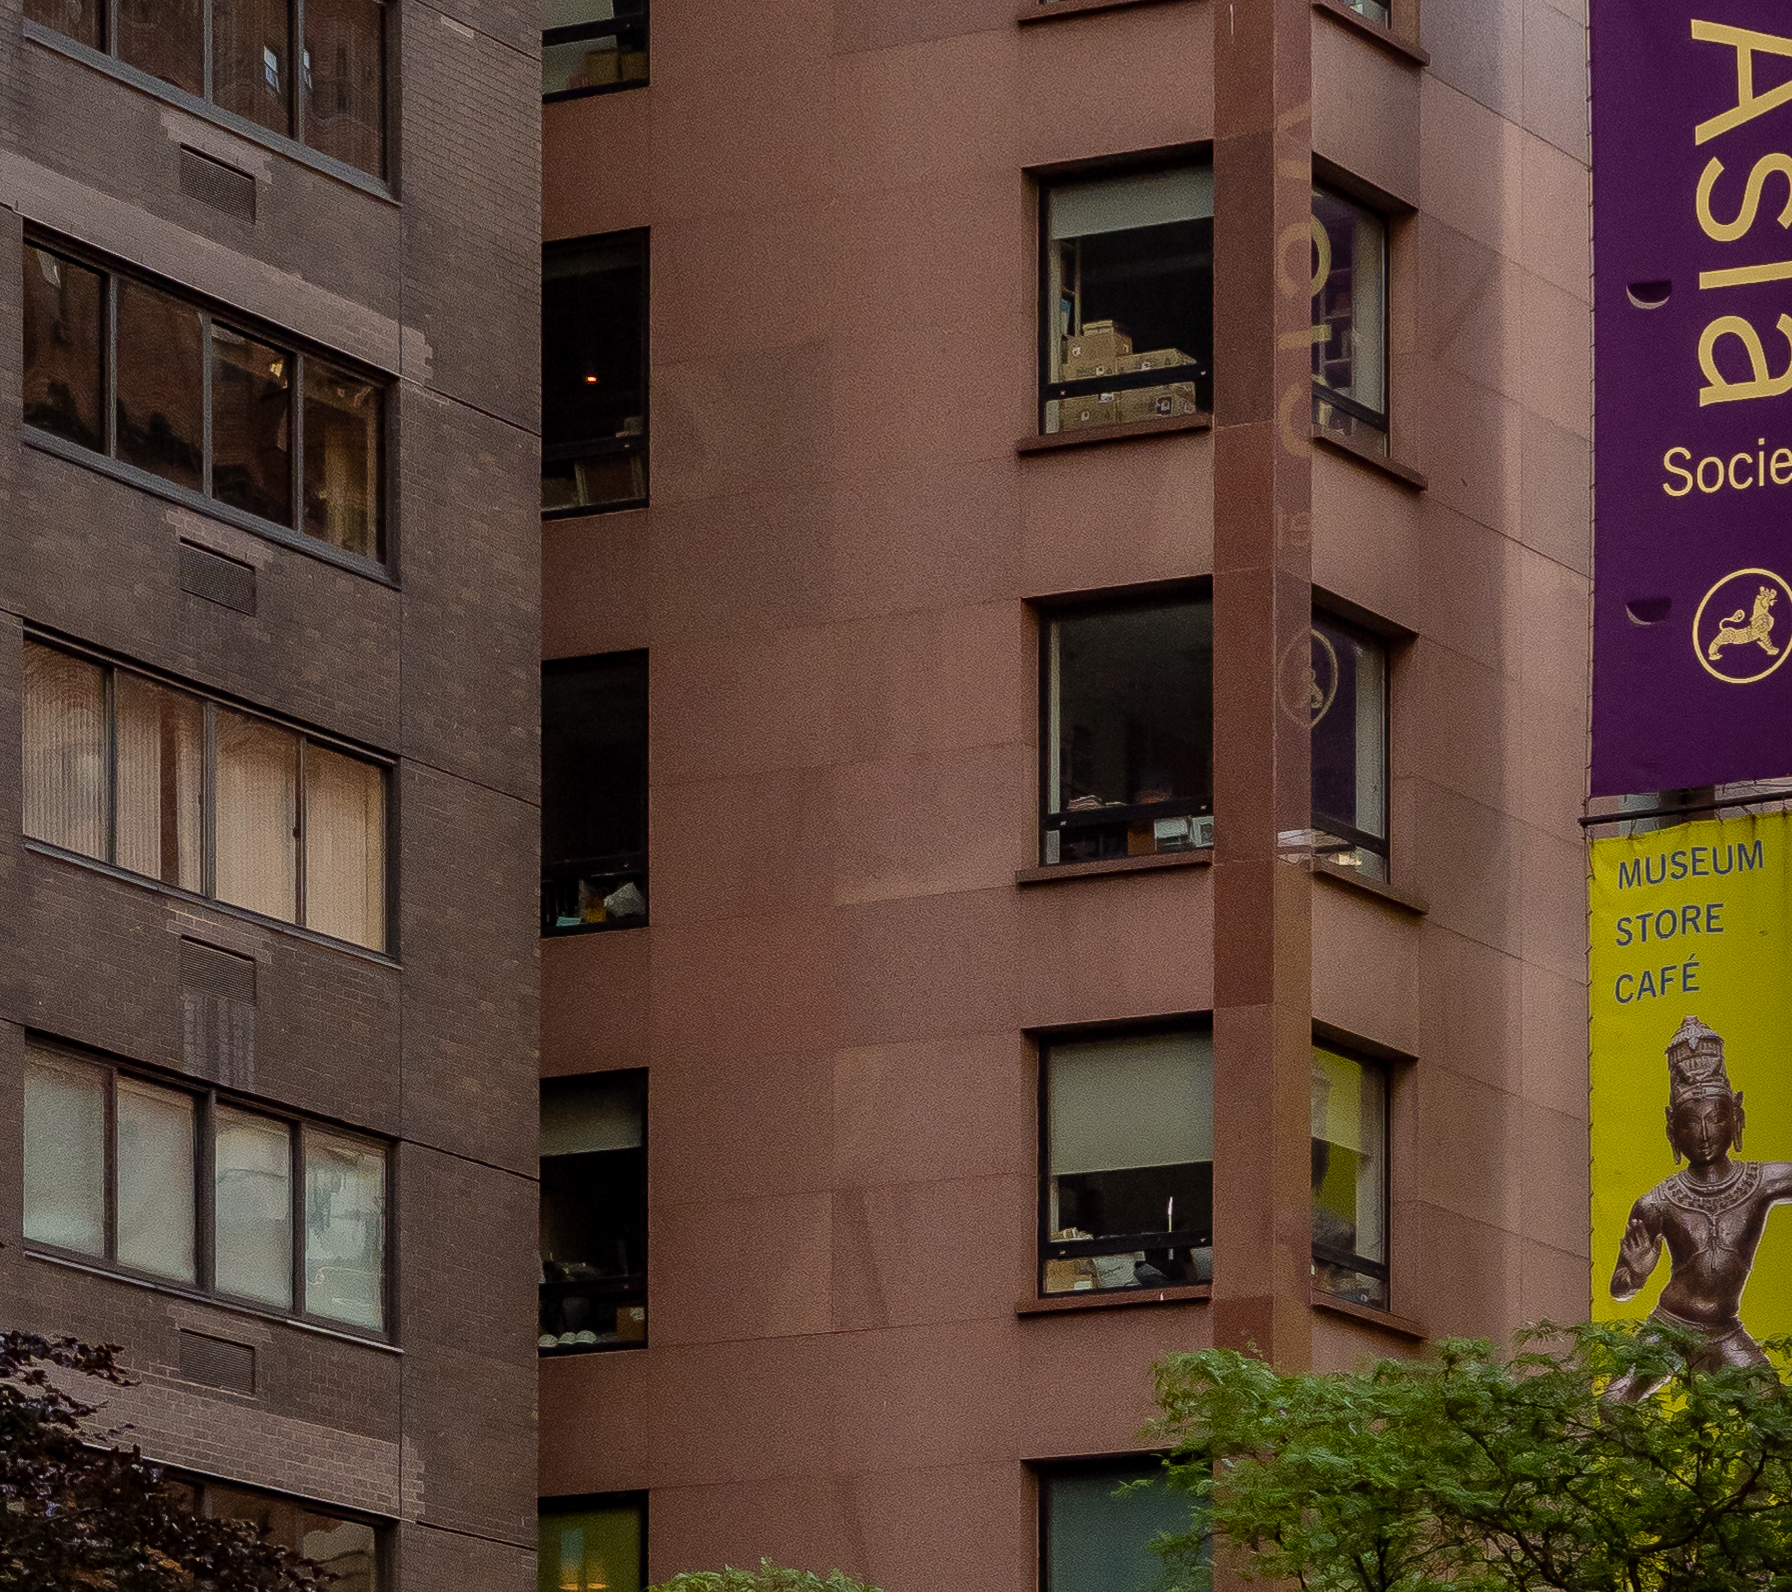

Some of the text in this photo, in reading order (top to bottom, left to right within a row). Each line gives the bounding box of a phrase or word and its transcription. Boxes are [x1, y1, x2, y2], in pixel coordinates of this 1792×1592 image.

[1617, 839, 1765, 891] MUSEUM
[1614, 903, 1725, 947] STORE
[1614, 953, 1701, 1004] CAFÉ
